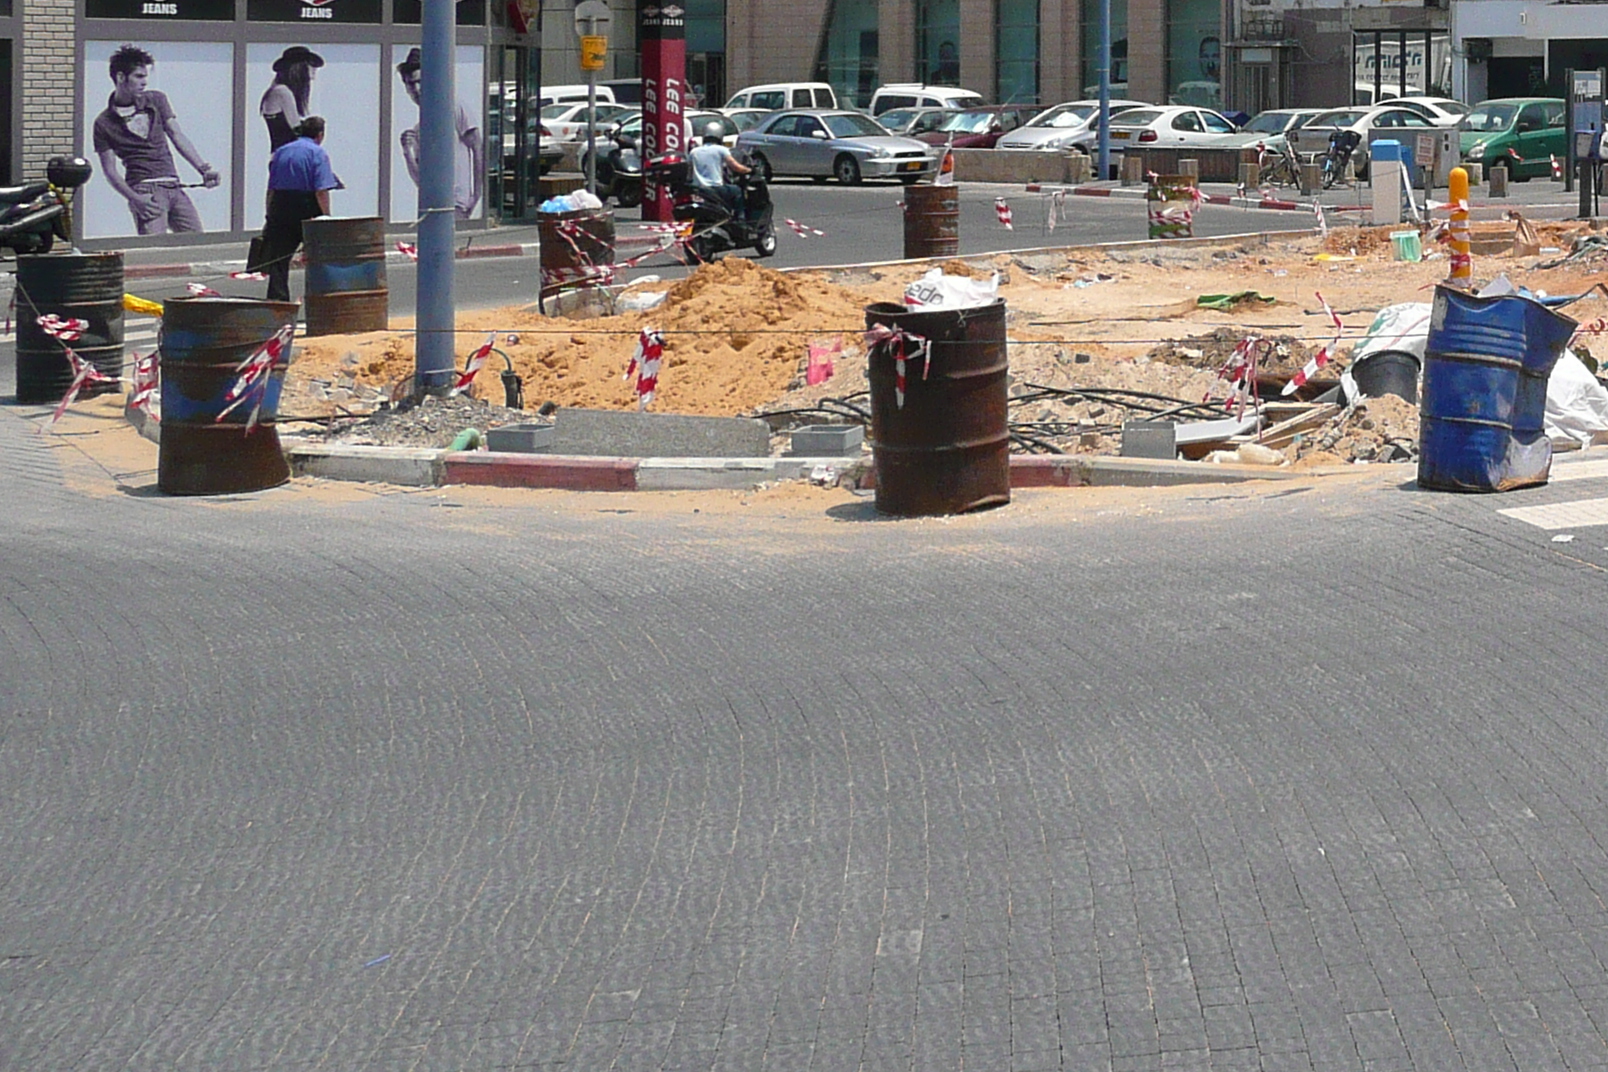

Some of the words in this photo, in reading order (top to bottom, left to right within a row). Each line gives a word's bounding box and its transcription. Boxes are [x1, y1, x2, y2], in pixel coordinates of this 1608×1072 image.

[142, 3, 178, 15] JEANS
[301, 7, 333, 19] JEANS
[666, 78, 680, 115] LEE
